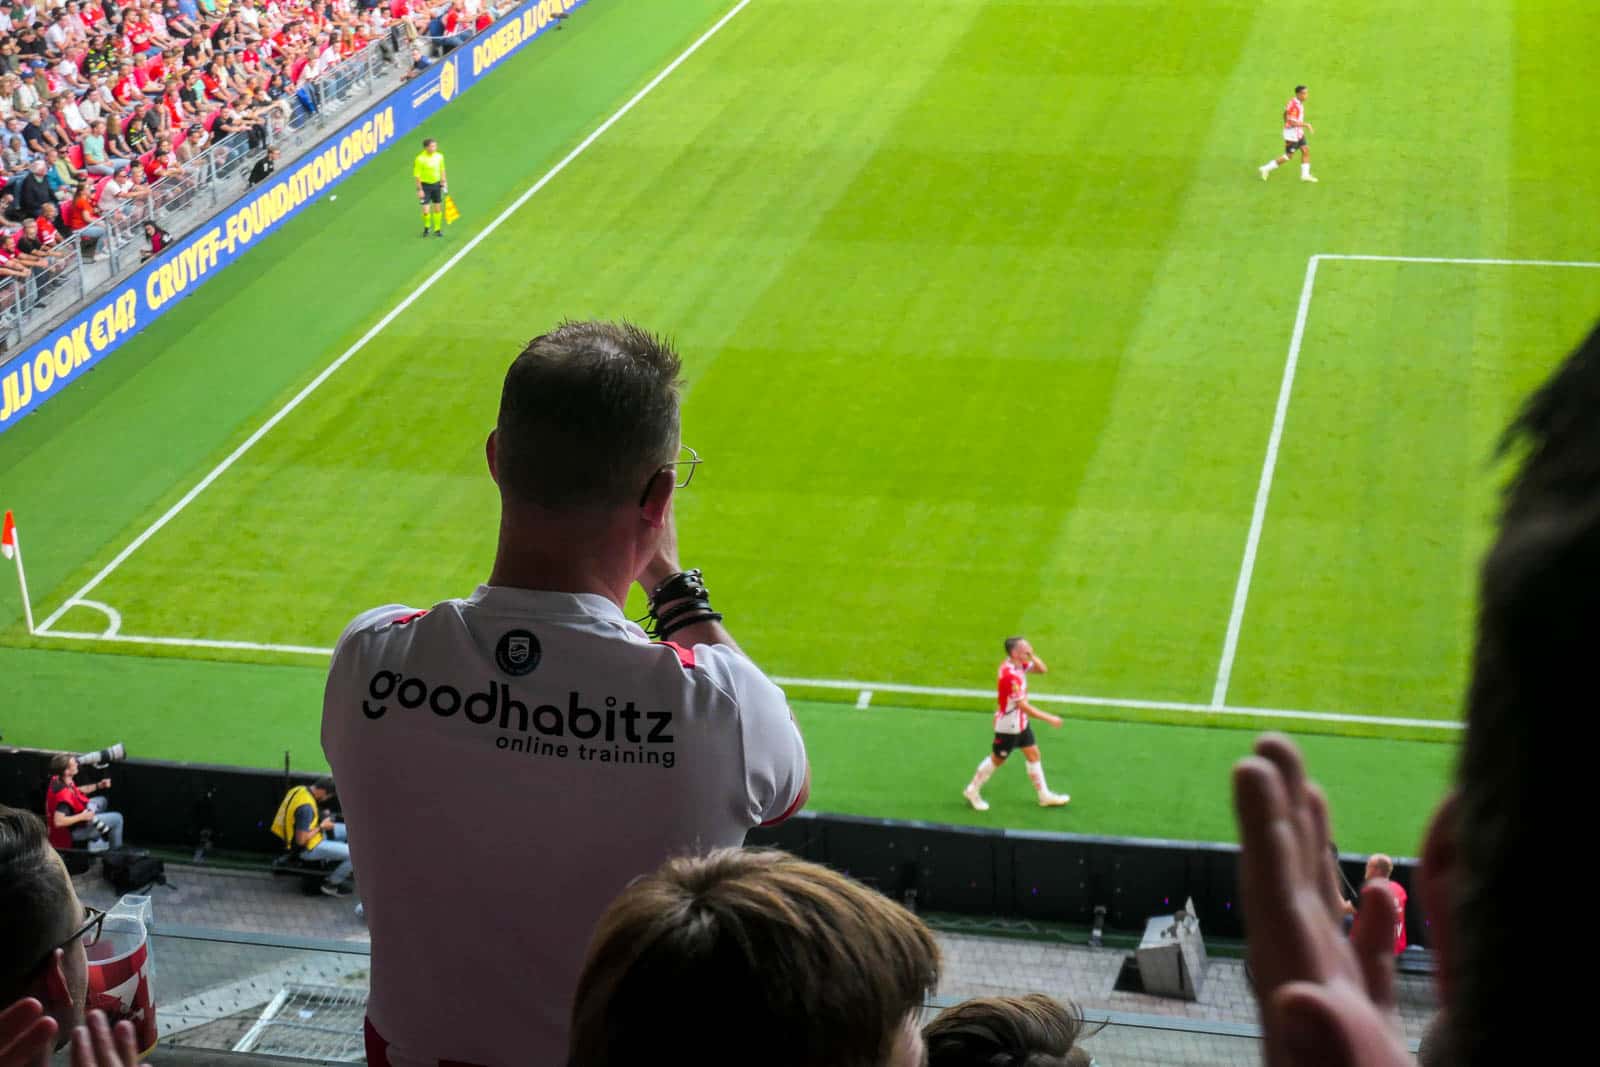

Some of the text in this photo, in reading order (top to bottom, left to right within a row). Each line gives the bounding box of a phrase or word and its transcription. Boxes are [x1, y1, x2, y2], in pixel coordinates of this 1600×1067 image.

[473, 17, 522, 76] DONEER
[0, 106, 394, 421] JIJ OOK €14? CRUYFF-FOUNDATION.ORG/14
[362, 669, 675, 744] goodhabitz
[496, 736, 675, 768] online training
